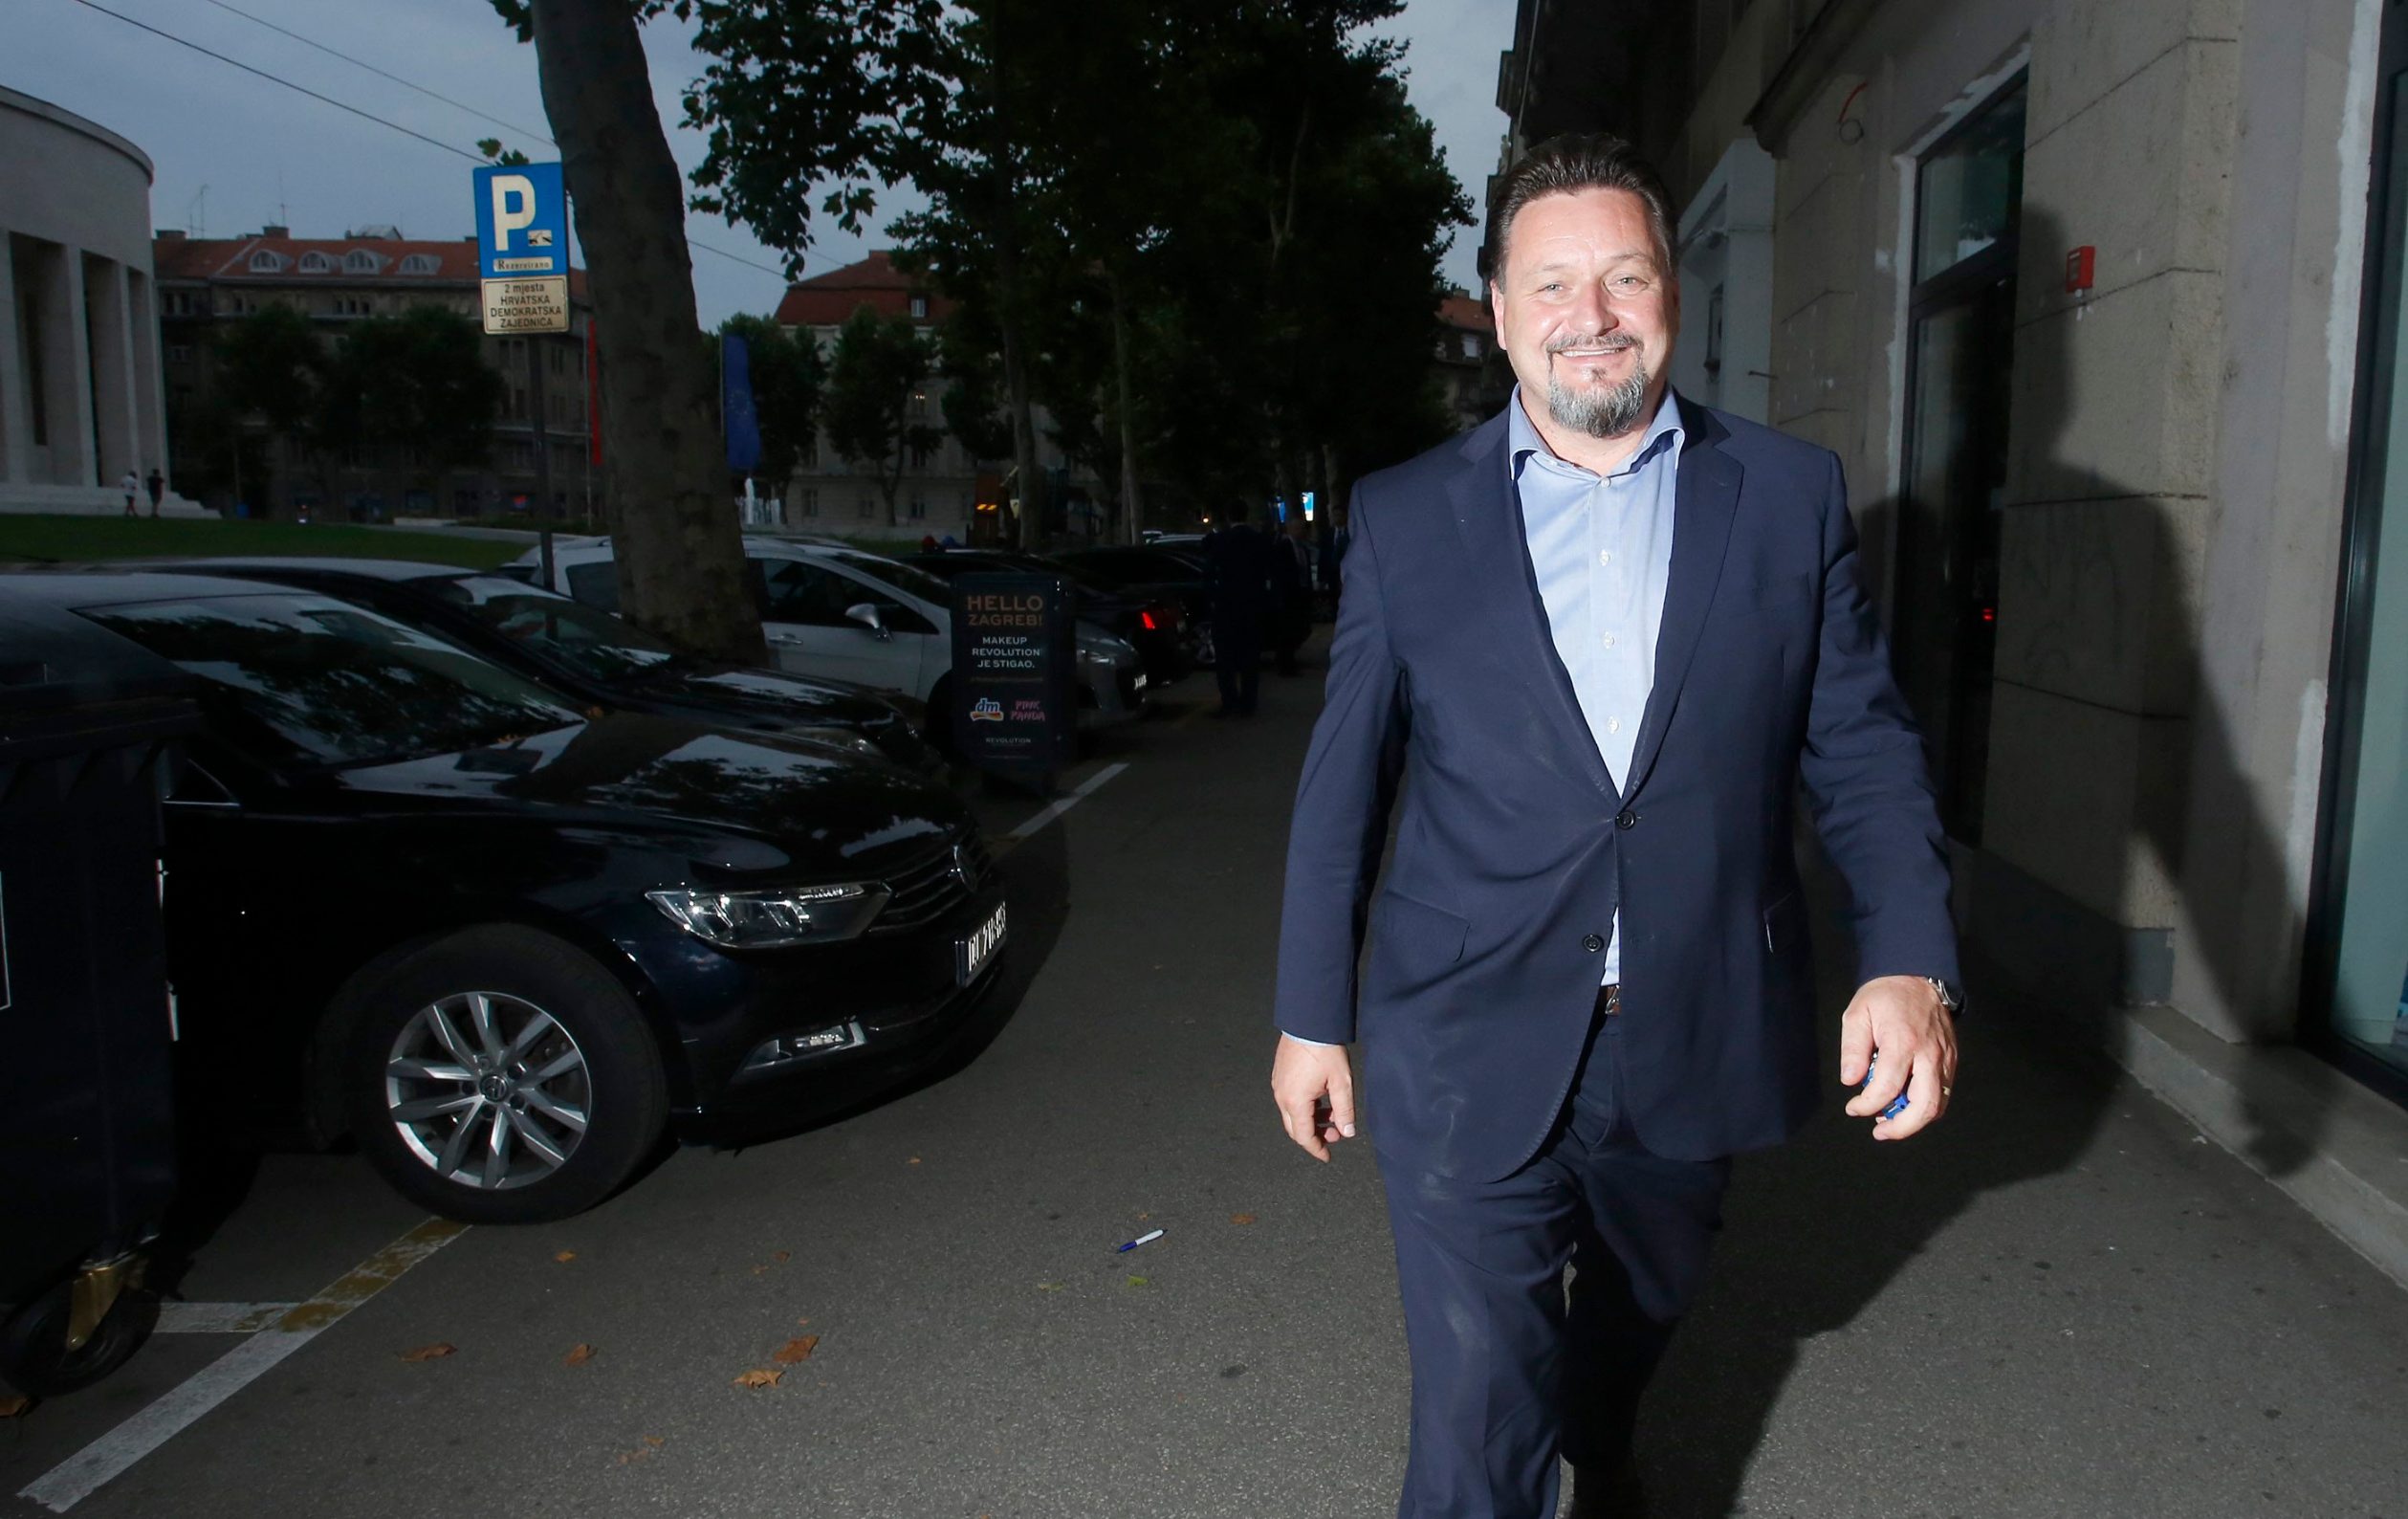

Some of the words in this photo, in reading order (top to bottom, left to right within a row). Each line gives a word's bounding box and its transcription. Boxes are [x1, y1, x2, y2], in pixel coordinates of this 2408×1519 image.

[491, 173, 536, 252] P
[504, 283, 510, 294] 2
[513, 282, 545, 296] mjesta
[501, 295, 551, 305] HRVATSKA
[490, 305, 562, 318] DEMOKRATSKA
[499, 318, 554, 328] ZAJEDNICA
[966, 594, 1044, 612] HELLO
[967, 613, 1043, 627] ZAGREB!
[981, 636, 1028, 646] MAKEUP
[972, 648, 1040, 657] REVOLUTION
[976, 659, 992, 669] JE
[993, 659, 1036, 669] STIGAO.
[1015, 699, 1041, 711] PINK
[1010, 710, 1046, 722] PANDA
